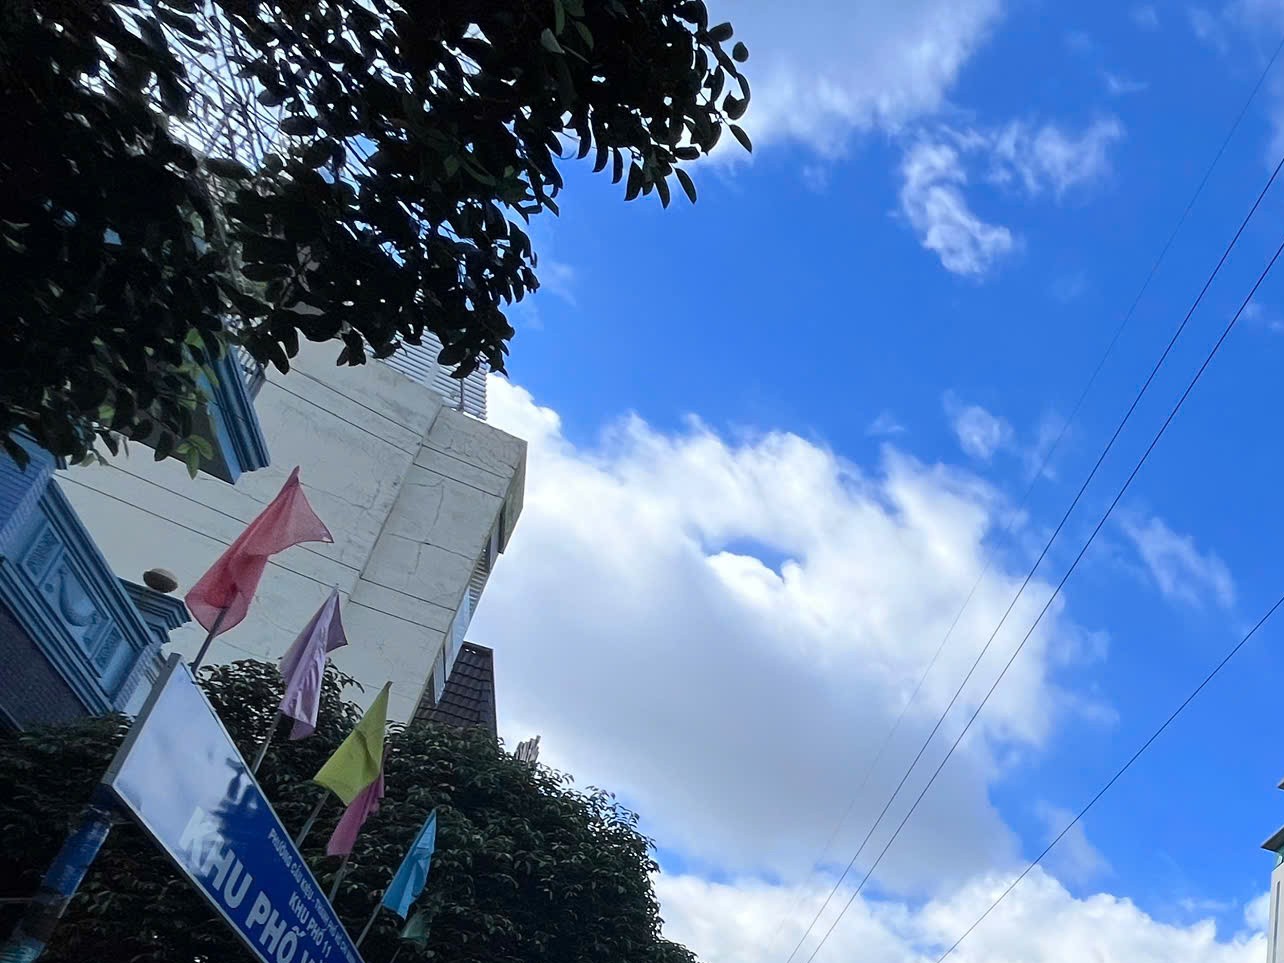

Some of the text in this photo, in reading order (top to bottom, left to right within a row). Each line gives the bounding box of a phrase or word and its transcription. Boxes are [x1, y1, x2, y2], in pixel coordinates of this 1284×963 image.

[178, 806, 254, 909] KHU
[289, 891, 332, 959] KHU PHỐ 11
